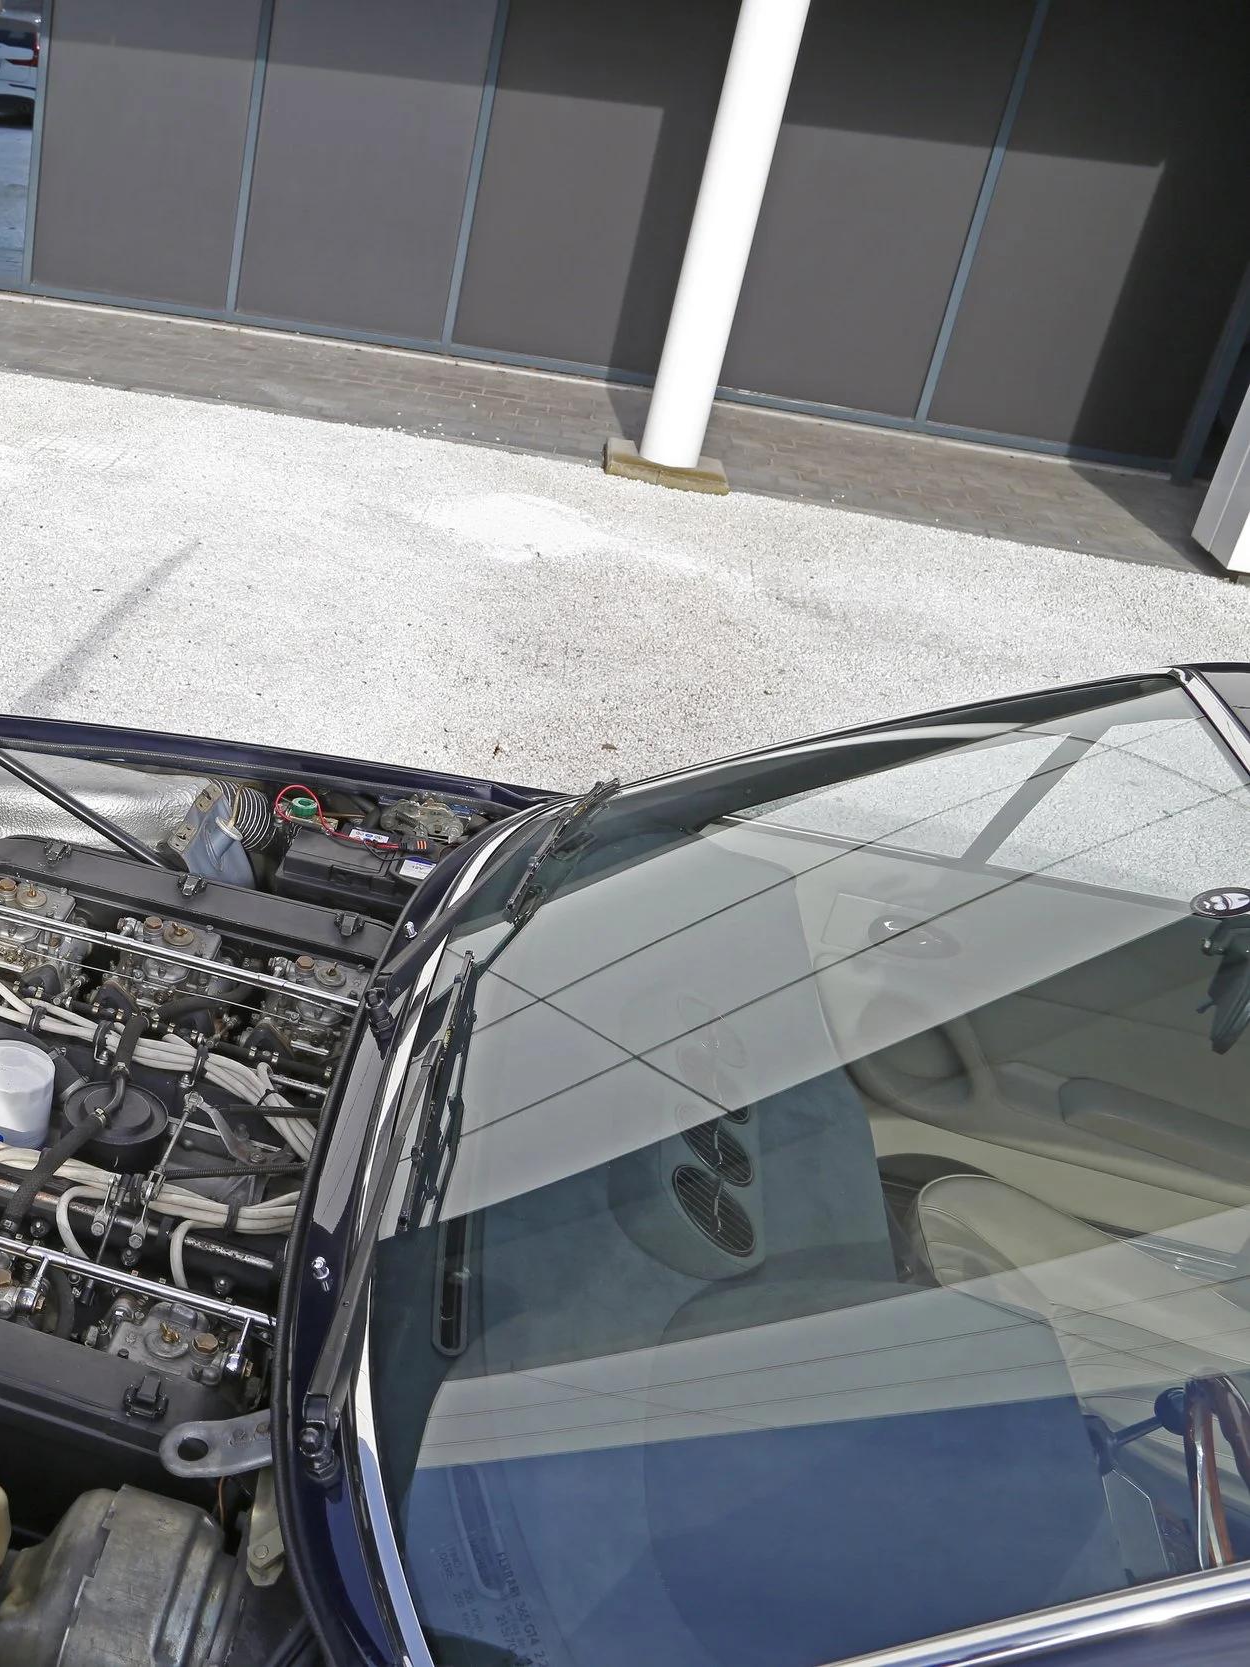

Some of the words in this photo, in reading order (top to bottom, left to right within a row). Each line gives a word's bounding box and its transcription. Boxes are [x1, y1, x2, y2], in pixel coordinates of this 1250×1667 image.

[496, 1551, 521, 1598] FERRARI
[514, 1601, 532, 1623] 365
[523, 1623, 541, 1646] GT4
